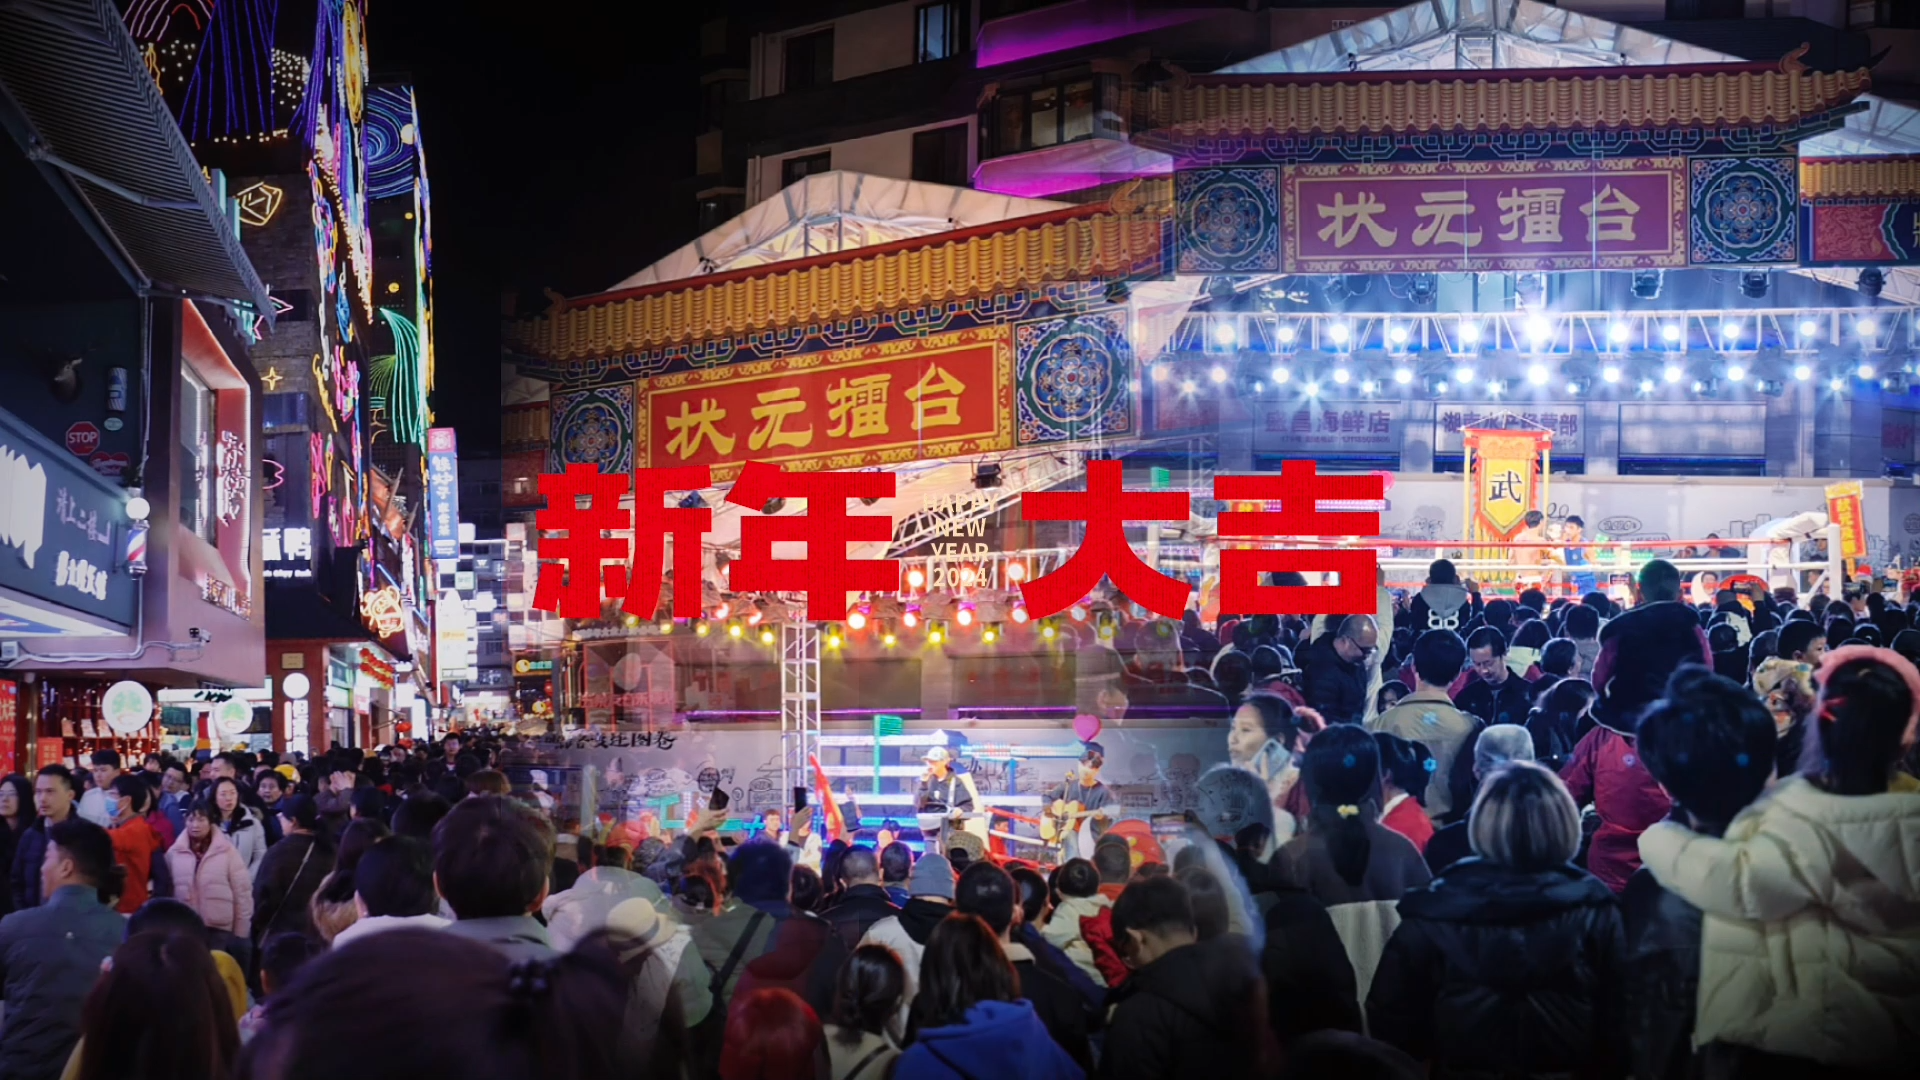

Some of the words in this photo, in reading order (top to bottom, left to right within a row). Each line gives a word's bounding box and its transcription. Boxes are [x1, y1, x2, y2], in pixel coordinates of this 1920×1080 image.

[1316, 183, 1641, 248] 状元擂台
[666, 362, 966, 461] 状元擂台
[69, 431, 98, 444] STOP
[1488, 470, 1523, 503] 武
